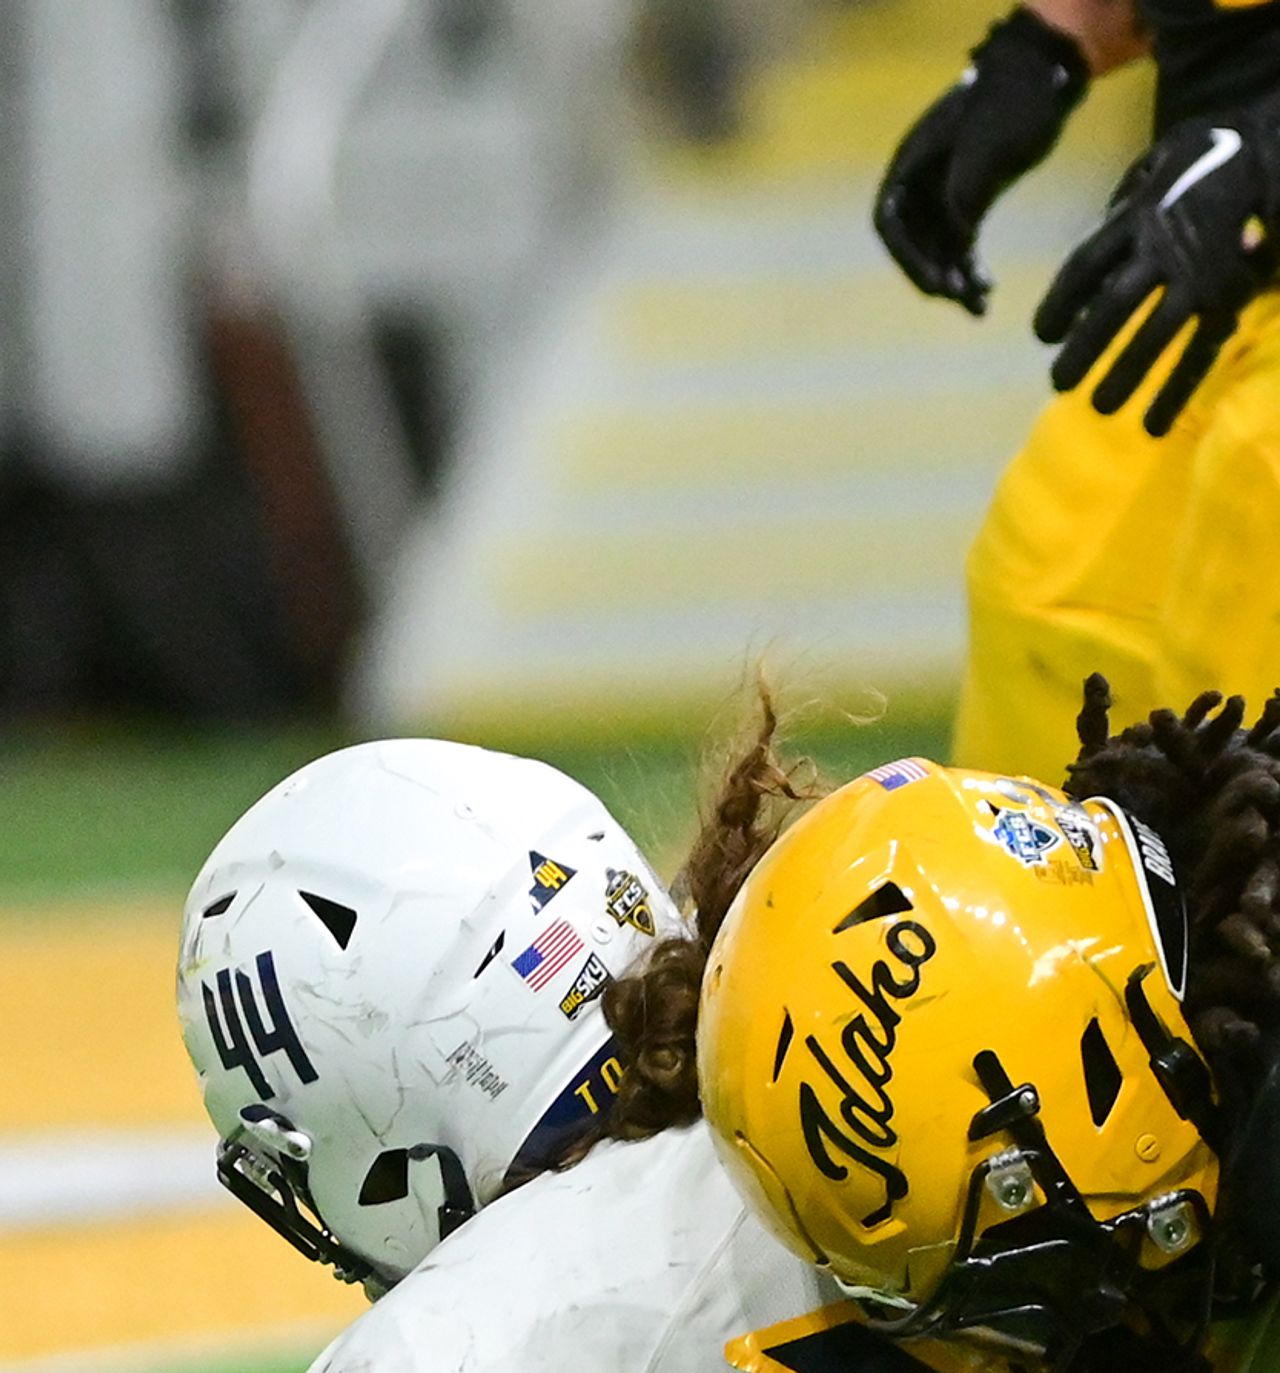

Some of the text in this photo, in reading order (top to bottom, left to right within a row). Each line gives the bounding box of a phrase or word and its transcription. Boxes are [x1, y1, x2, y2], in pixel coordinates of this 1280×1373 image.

[534, 859, 568, 889] 44
[613, 881, 642, 917] FCS
[201, 950, 320, 1100] 44
[799, 919, 937, 1230] Idaho
